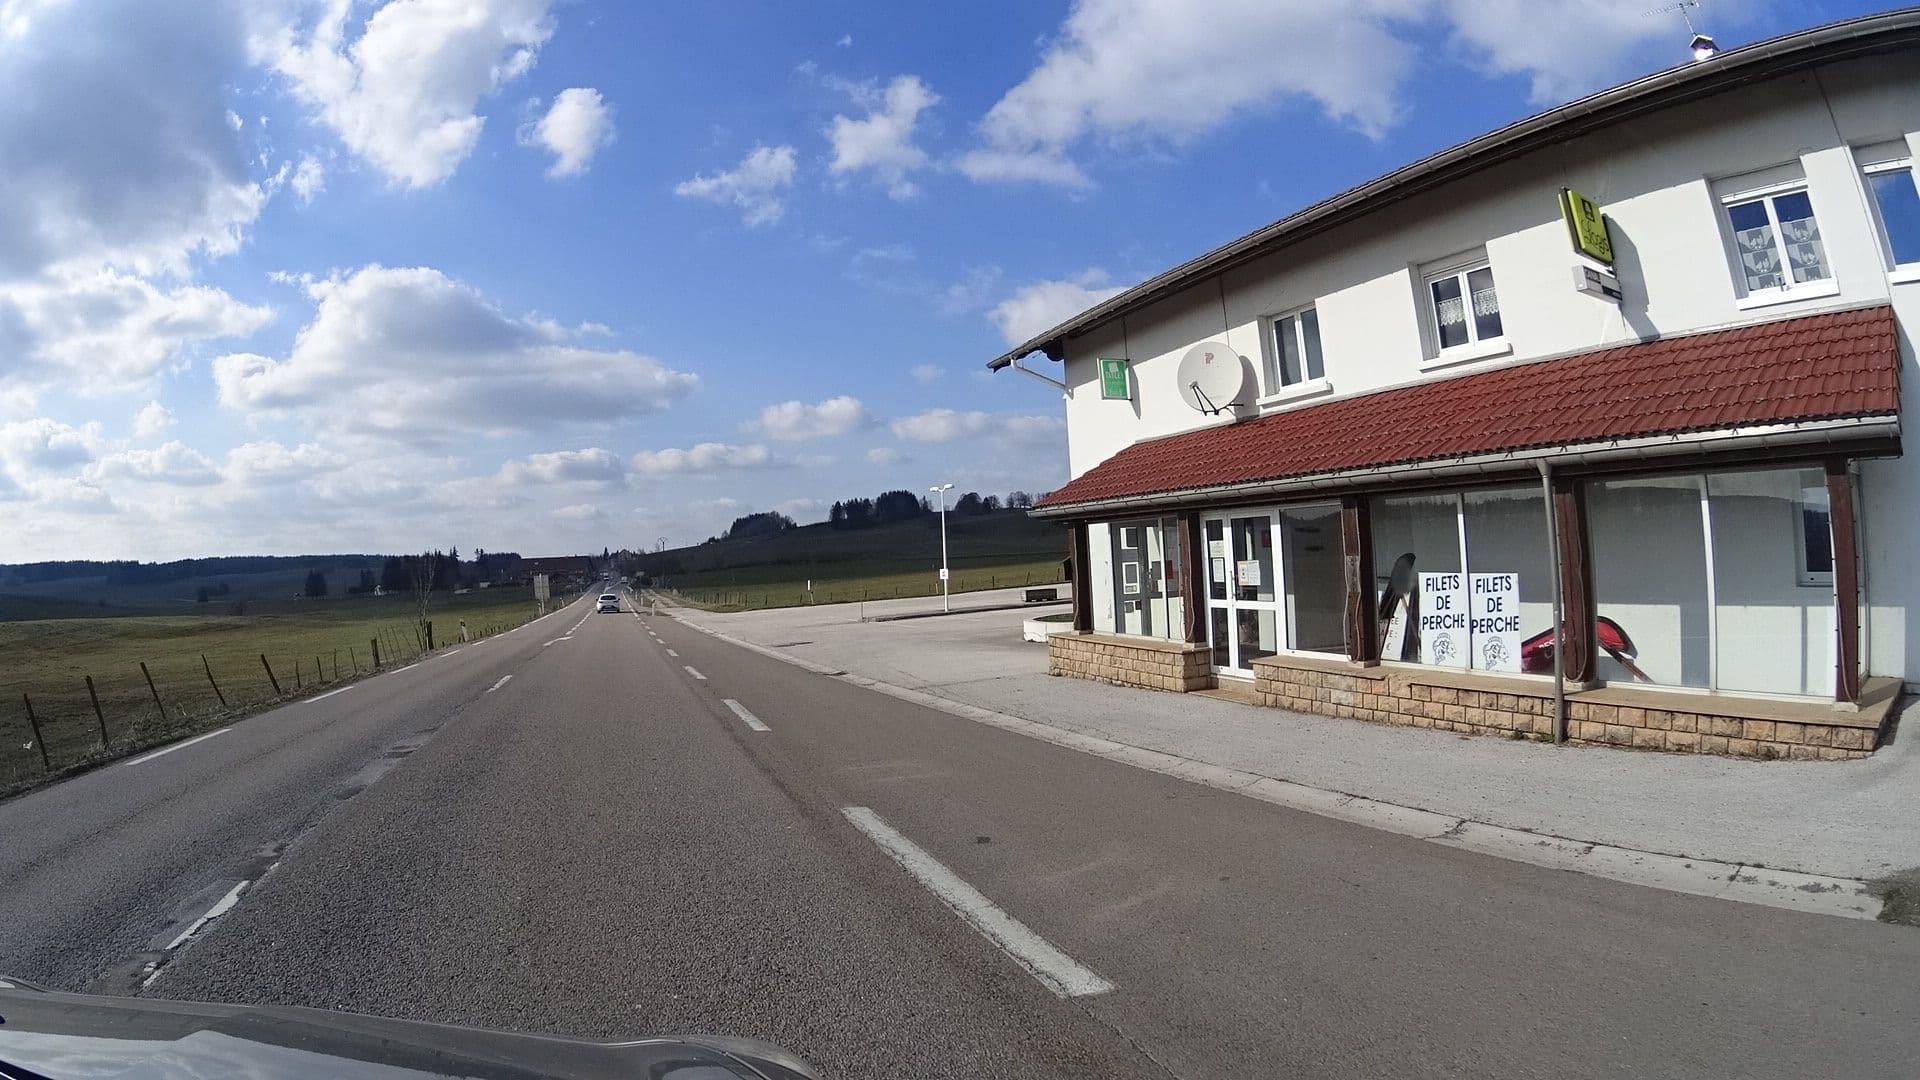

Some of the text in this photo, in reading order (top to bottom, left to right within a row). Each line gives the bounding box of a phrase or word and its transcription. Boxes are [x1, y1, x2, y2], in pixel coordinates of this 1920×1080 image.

[1425, 574, 1460, 593] FILETS
[1475, 575, 1512, 594] FILETS
[1436, 595, 1451, 611] DE
[1487, 597, 1503, 613] DE
[1422, 613, 1465, 631] PERCHE
[1471, 615, 1520, 635] PERCHE
